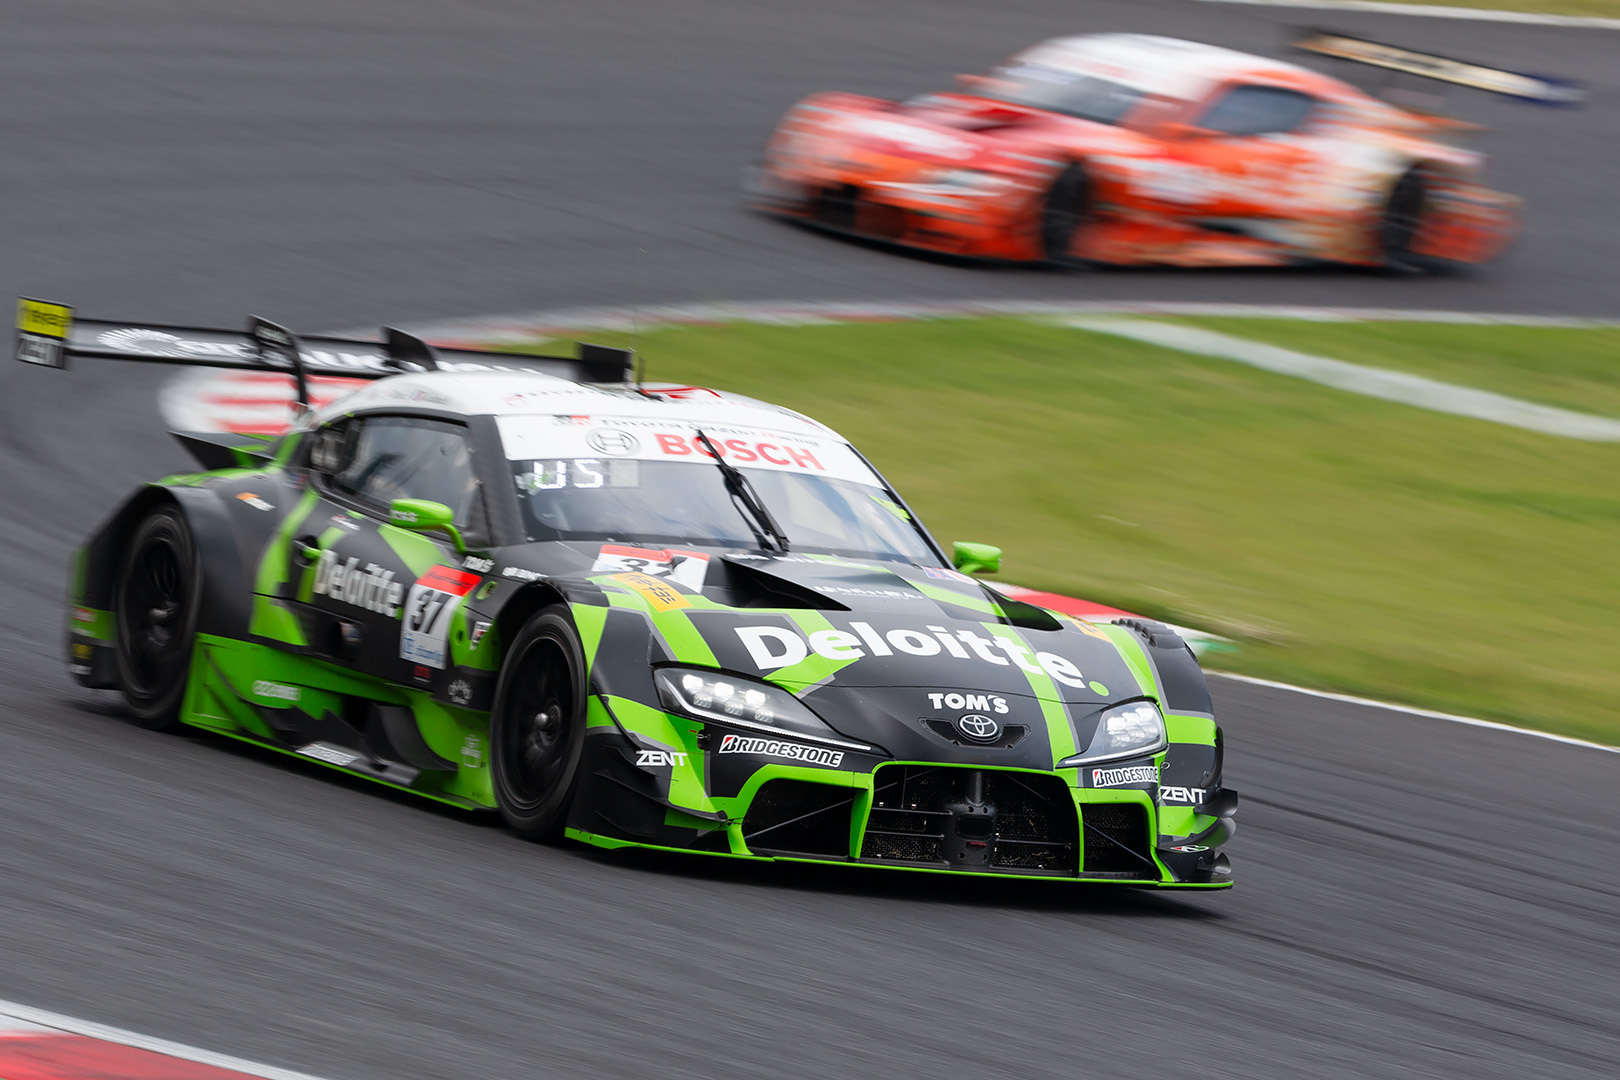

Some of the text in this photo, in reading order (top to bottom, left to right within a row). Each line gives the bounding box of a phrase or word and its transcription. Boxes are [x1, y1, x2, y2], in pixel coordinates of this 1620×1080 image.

[654, 433, 826, 471] BOSCH
[409, 589, 453, 635] 37
[928, 693, 1009, 715] TOM'S
[636, 749, 687, 767] ZENT
[719, 735, 844, 768] BRIDGESTONE
[1093, 766, 1158, 788] BRIDGESTONE
[1160, 786, 1207, 804] ZENT
